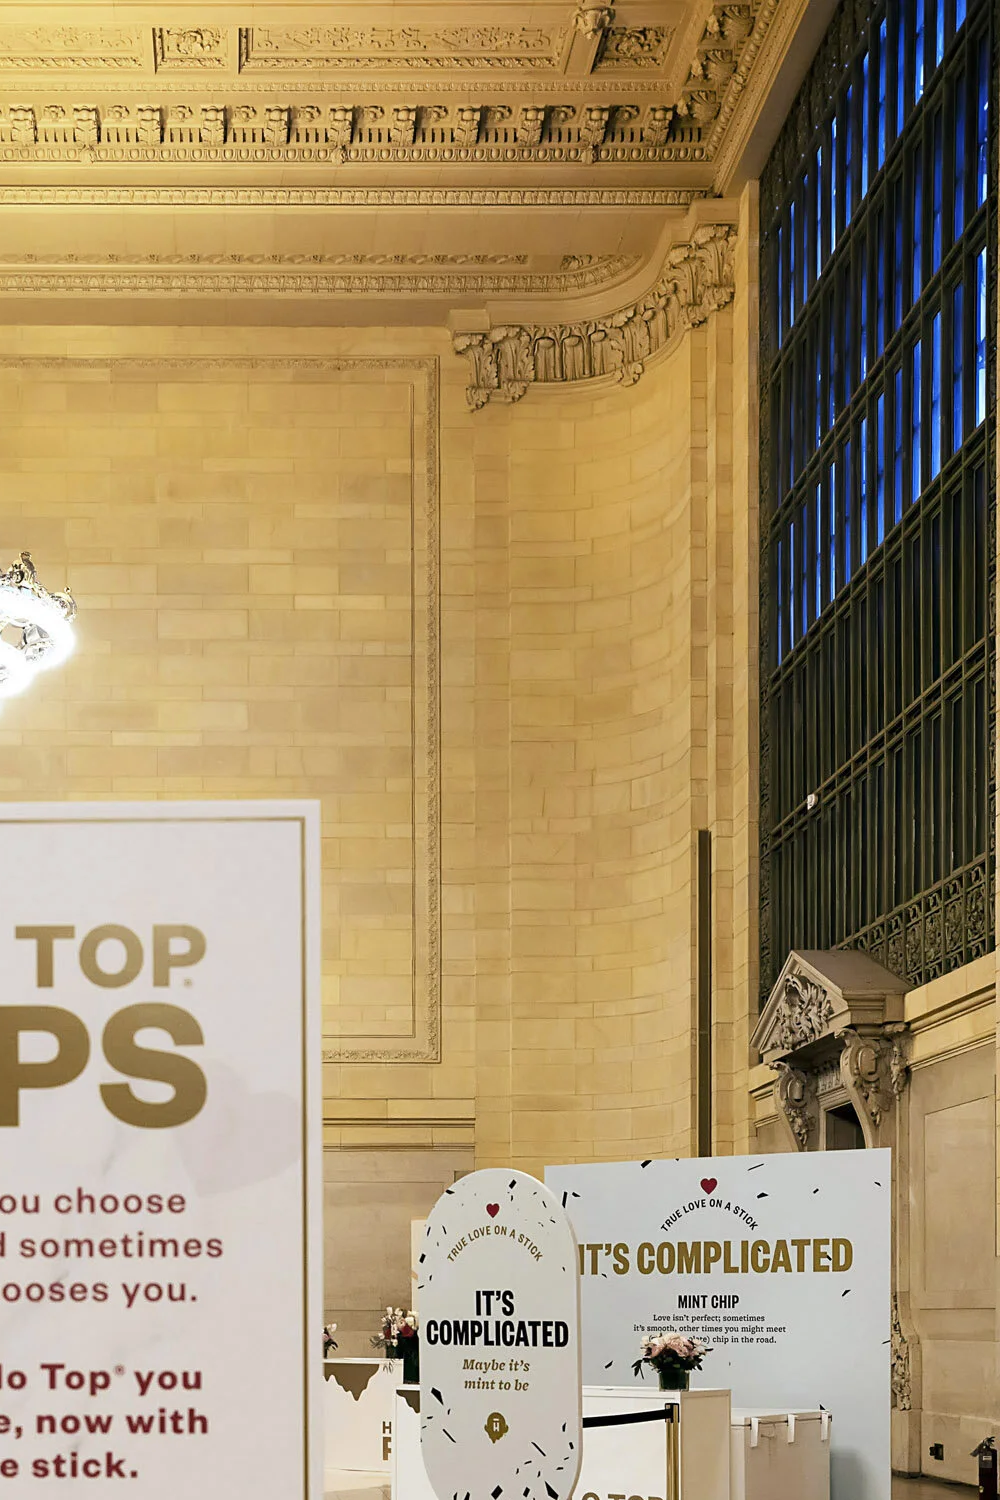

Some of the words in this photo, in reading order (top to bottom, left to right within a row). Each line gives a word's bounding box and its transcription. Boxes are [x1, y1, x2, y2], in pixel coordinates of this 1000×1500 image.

[53, 1188, 187, 1215] choose
[660, 1209, 683, 1232] TRUE
[682, 1198, 707, 1213] LOVE
[709, 1198, 722, 1208] ON
[724, 1201, 732, 1212] A
[733, 1206, 759, 1231] STICK
[20, 1231, 223, 1259] sometimes
[446, 1240, 468, 1263] TRUE
[467, 1225, 492, 1243] LOVE
[494, 1225, 507, 1235] ON
[509, 1228, 517, 1239] A
[517, 1232, 544, 1262] STICK
[637, 1238, 853, 1274] COMPLICATED
[122, 1283, 198, 1309] you.
[475, 1290, 514, 1317] IT'S
[678, 1295, 707, 1309] MINT
[711, 1295, 739, 1309] CHIP
[646, 1325, 676, 1334] smooth,
[679, 1325, 699, 1333] other
[701, 1325, 723, 1333] times
[724, 1327, 739, 1336] you
[741, 1325, 763, 1336] might
[765, 1325, 786, 1333] meet
[653, 1314, 671, 1322] Love
[691, 1314, 720, 1323] perfect;
[722, 1314, 765, 1322] sometimes
[426, 1319, 569, 1348] COMPLICATED
[712, 1336, 729, 1346] chip
[755, 1336, 777, 1344] road.
[463, 1358, 506, 1374] Maybe
[134, 1371, 203, 1395] you
[465, 1378, 496, 1390] mint
[498, 1379, 512, 1391] to
[514, 1379, 529, 1392] be
[37, 1414, 113, 1434] now
[126, 1406, 208, 1434] with
[32, 1450, 139, 1479] stick.
